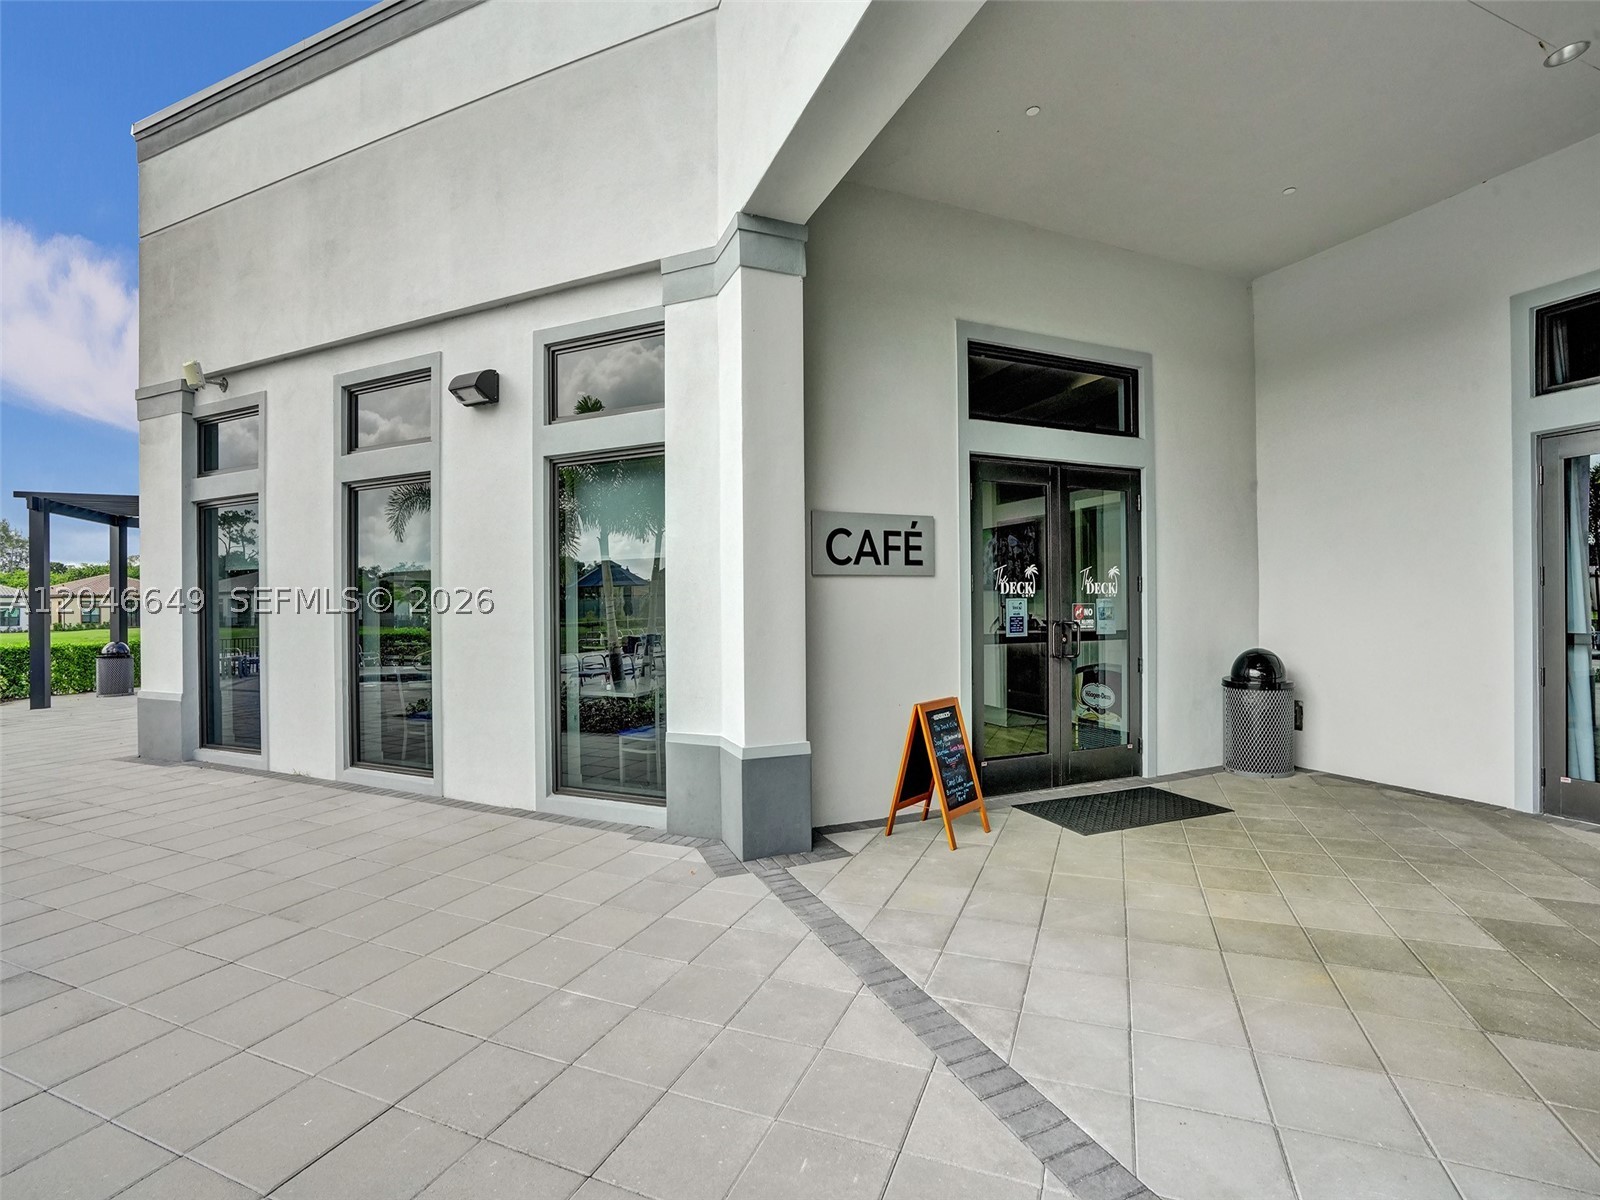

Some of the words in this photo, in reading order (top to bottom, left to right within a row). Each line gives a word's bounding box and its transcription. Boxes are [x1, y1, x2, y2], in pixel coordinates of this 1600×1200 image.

[825, 520, 924, 566] CAFÉ
[992, 564, 1009, 591] The
[1079, 565, 1094, 591] The
[1000, 581, 1034, 595] DECK
[1086, 582, 1116, 595] DECK
[1083, 608, 1093, 616] NO
